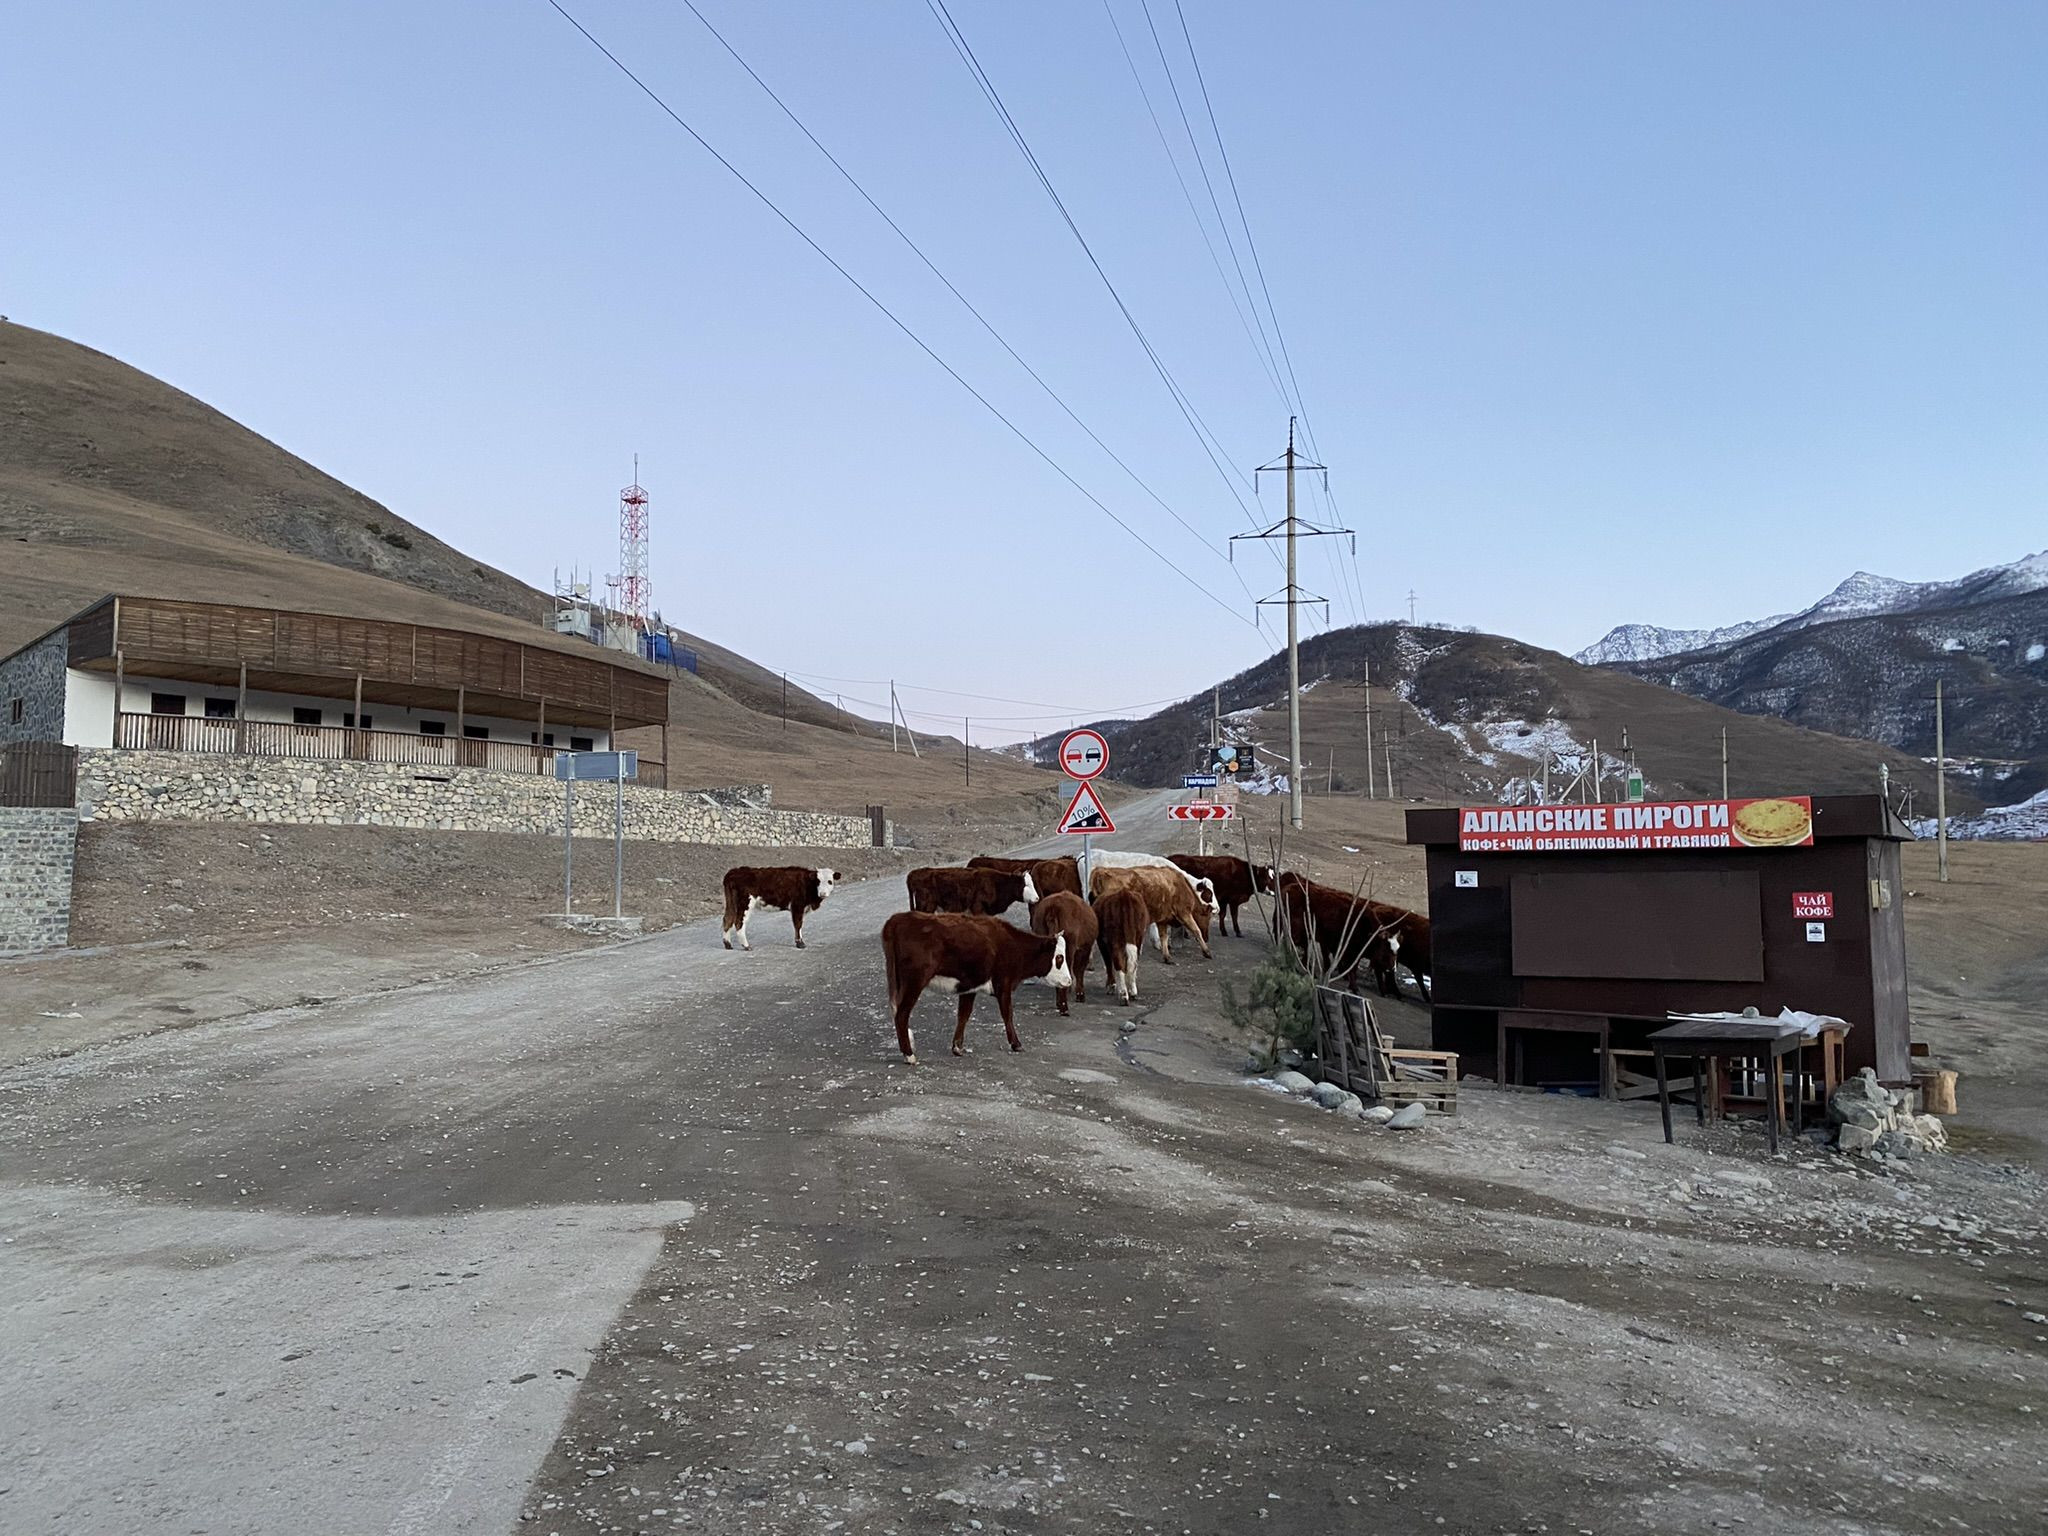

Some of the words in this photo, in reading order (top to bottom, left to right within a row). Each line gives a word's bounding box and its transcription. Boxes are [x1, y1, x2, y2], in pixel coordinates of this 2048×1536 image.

[1071, 804, 1096, 821] 10%
[1463, 808, 1608, 833] АЛАНСКИЕ
[1613, 804, 1729, 830] ПИРОГИ
[1535, 834, 1639, 851] ОБЛЕПИХОВЫЙ
[1642, 836, 1652, 849] И
[1654, 832, 1730, 849] ТРАВЯНОЙ
[1799, 894, 1826, 906] ЧАЙ
[1796, 906, 1831, 917] КОФЕ
